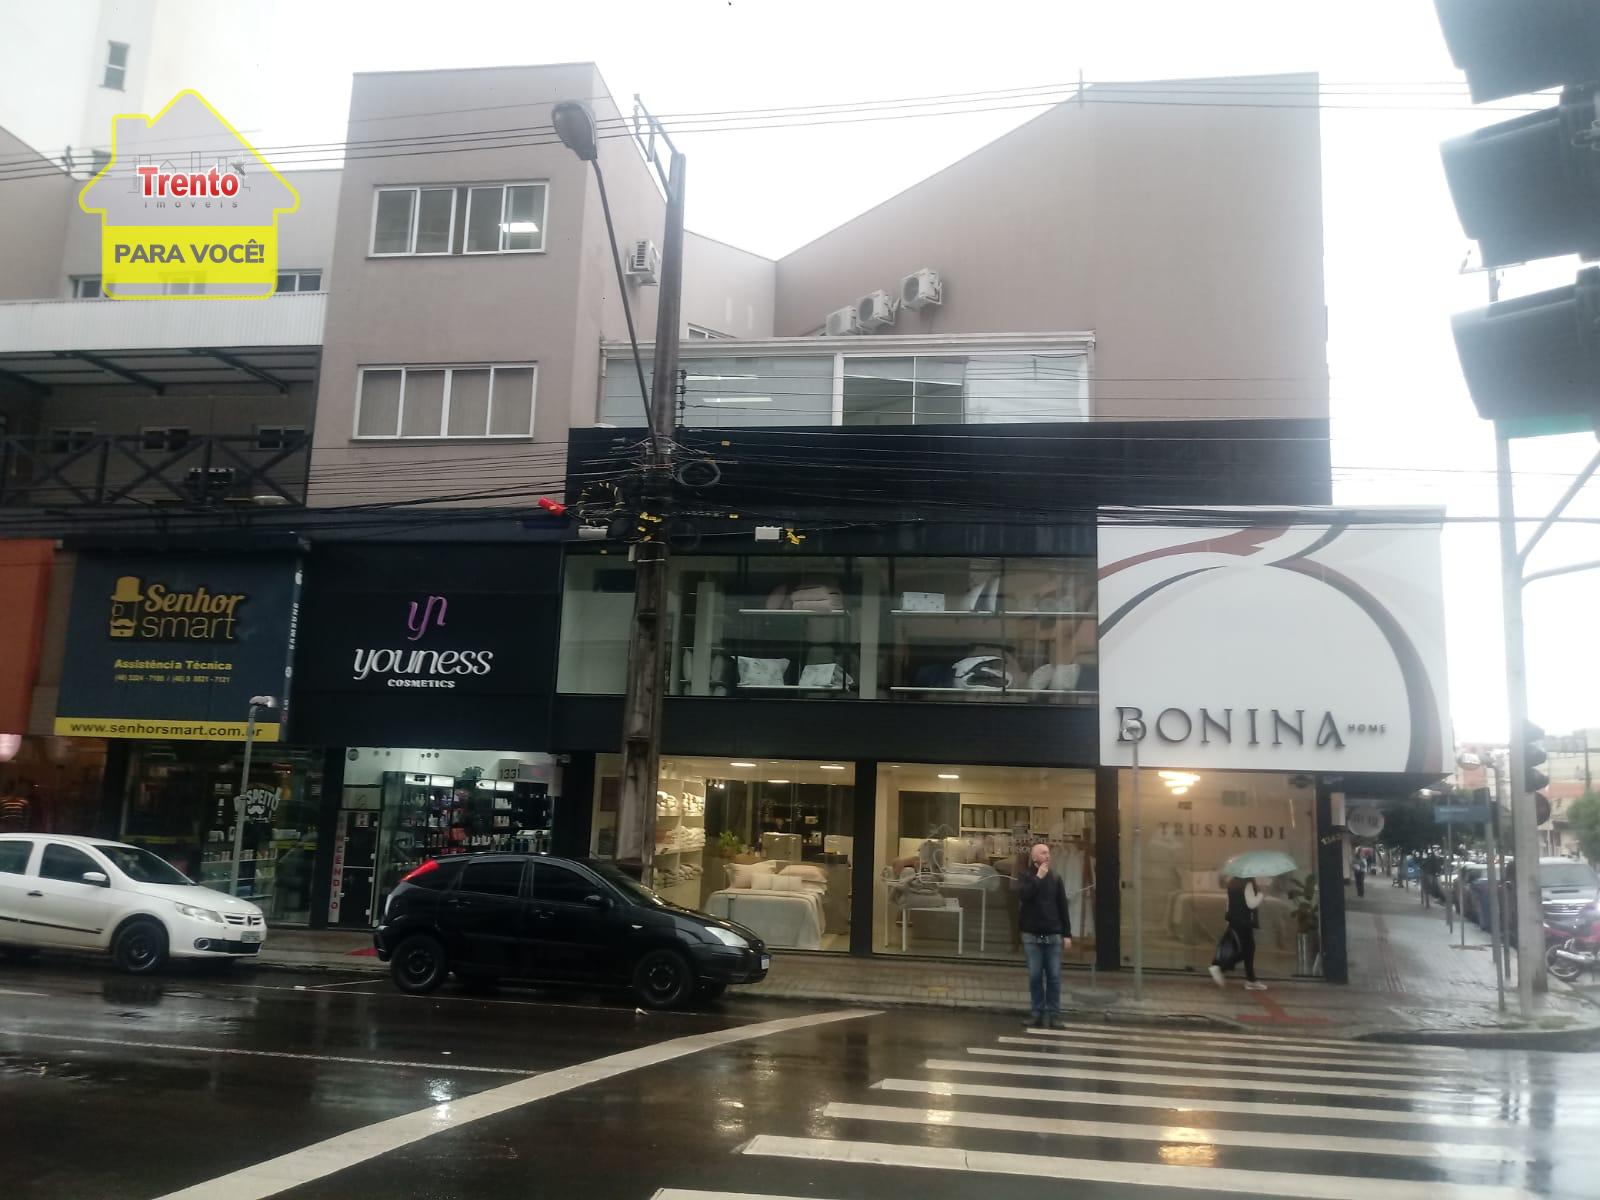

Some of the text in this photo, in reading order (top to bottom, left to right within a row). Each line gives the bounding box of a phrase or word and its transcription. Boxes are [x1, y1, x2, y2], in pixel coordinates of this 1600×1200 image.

[144, 584, 245, 616] Senhor
[141, 613, 236, 640] smart
[185, 660, 232, 671] Técnica
[353, 648, 494, 680] youness
[387, 678, 456, 689] COSMETICS
[1114, 706, 1387, 748] BONINA HOME
[233, 787, 282, 812] RSPEITO
[1158, 821, 1286, 840] TRUSSARDI
